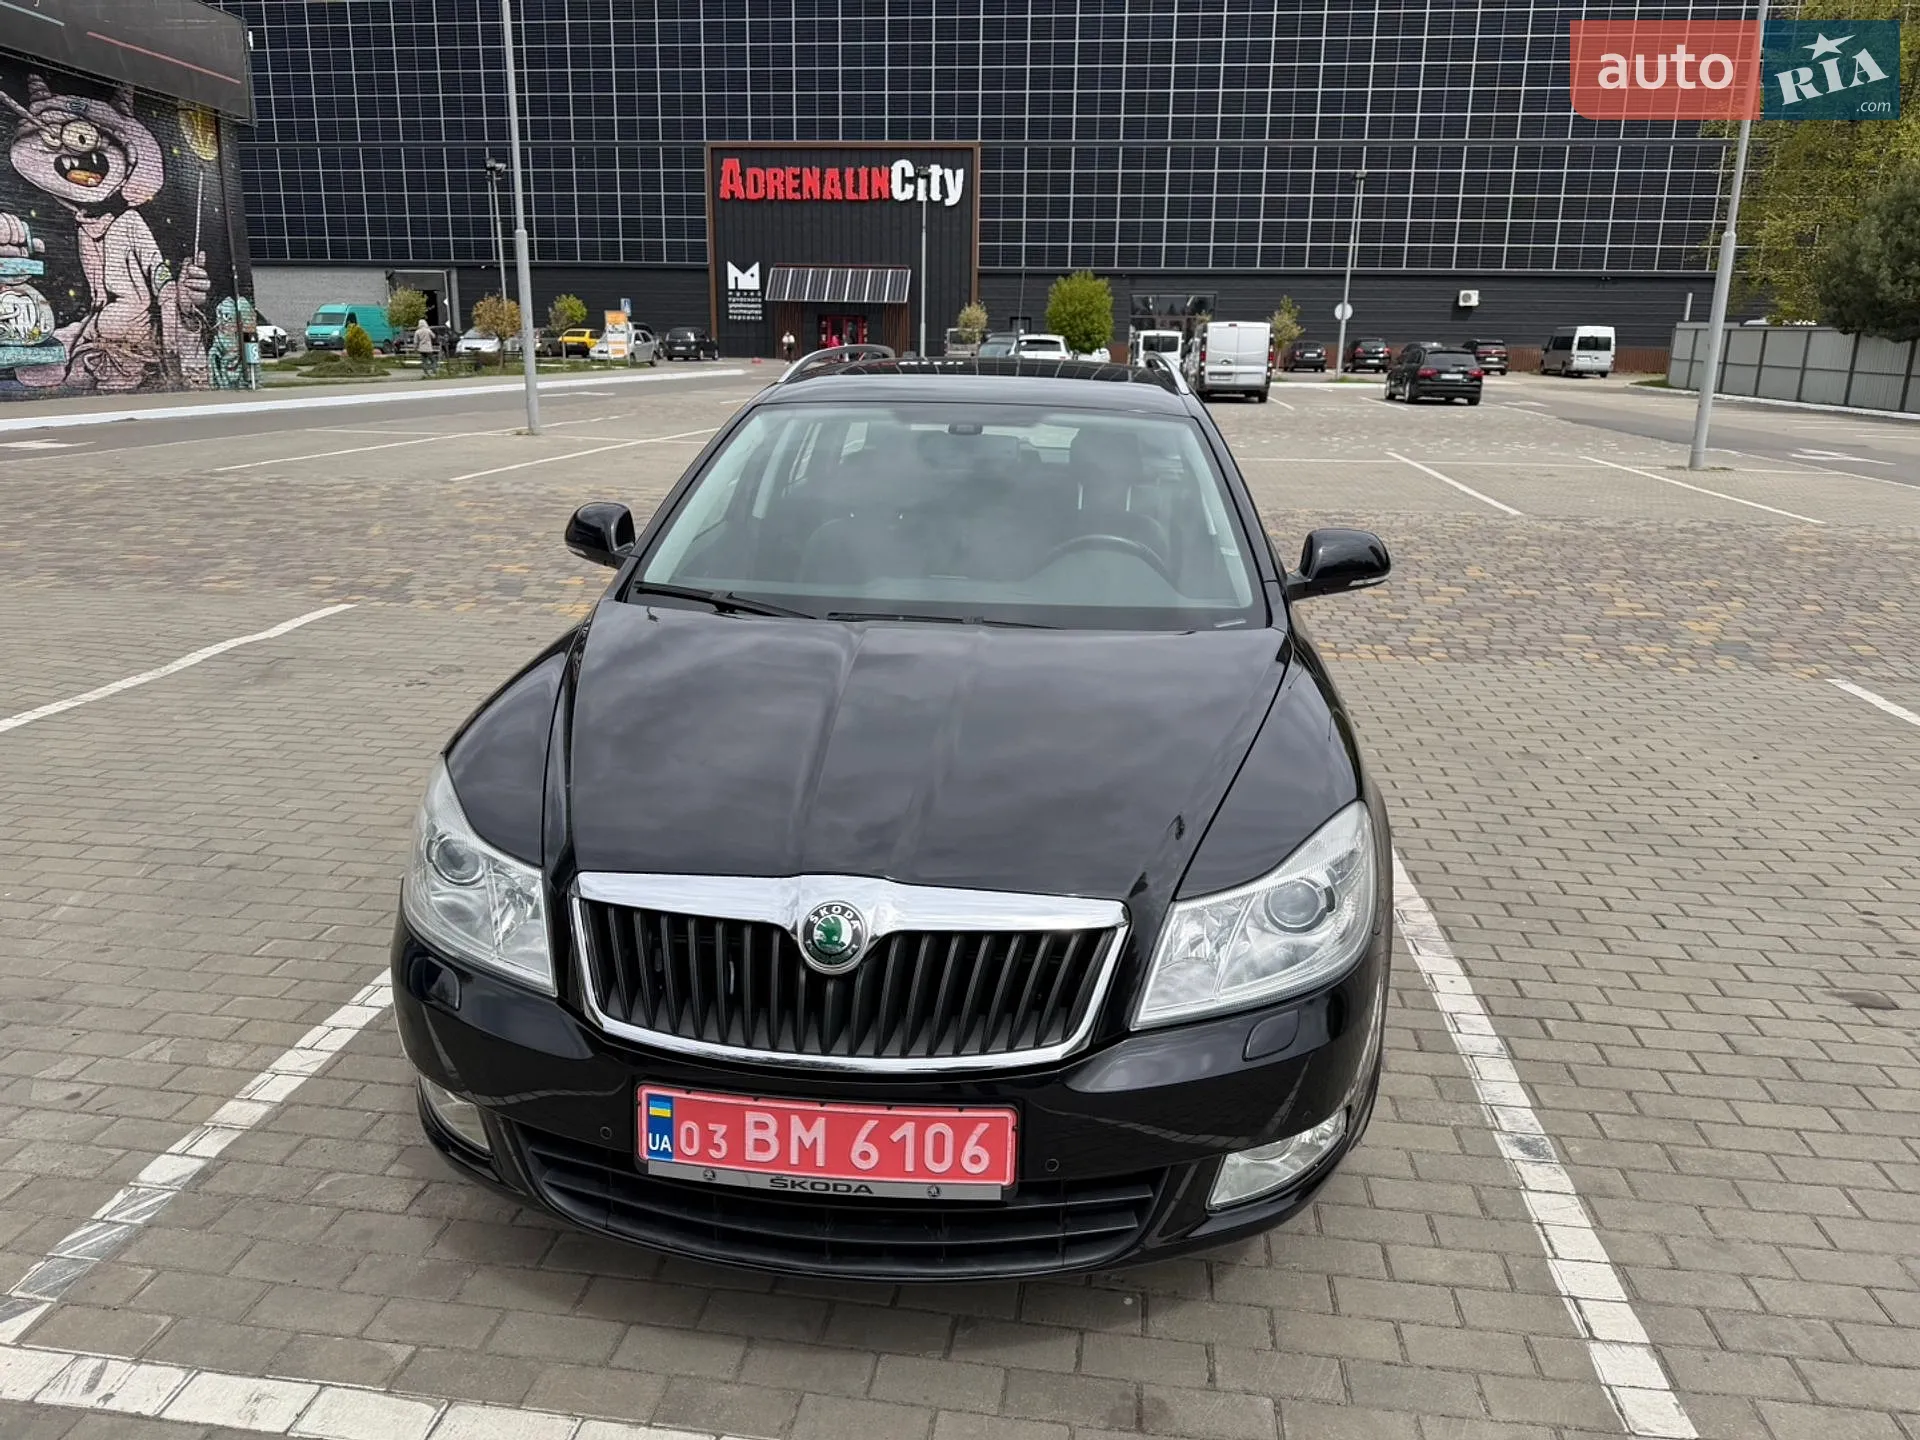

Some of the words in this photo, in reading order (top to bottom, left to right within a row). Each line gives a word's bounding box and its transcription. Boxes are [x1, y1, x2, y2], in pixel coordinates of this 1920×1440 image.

[648, 1132, 672, 1152] UA
[679, 1120, 729, 1159] 03
[744, 1111, 826, 1167] BM
[849, 1119, 991, 1175] 6106
